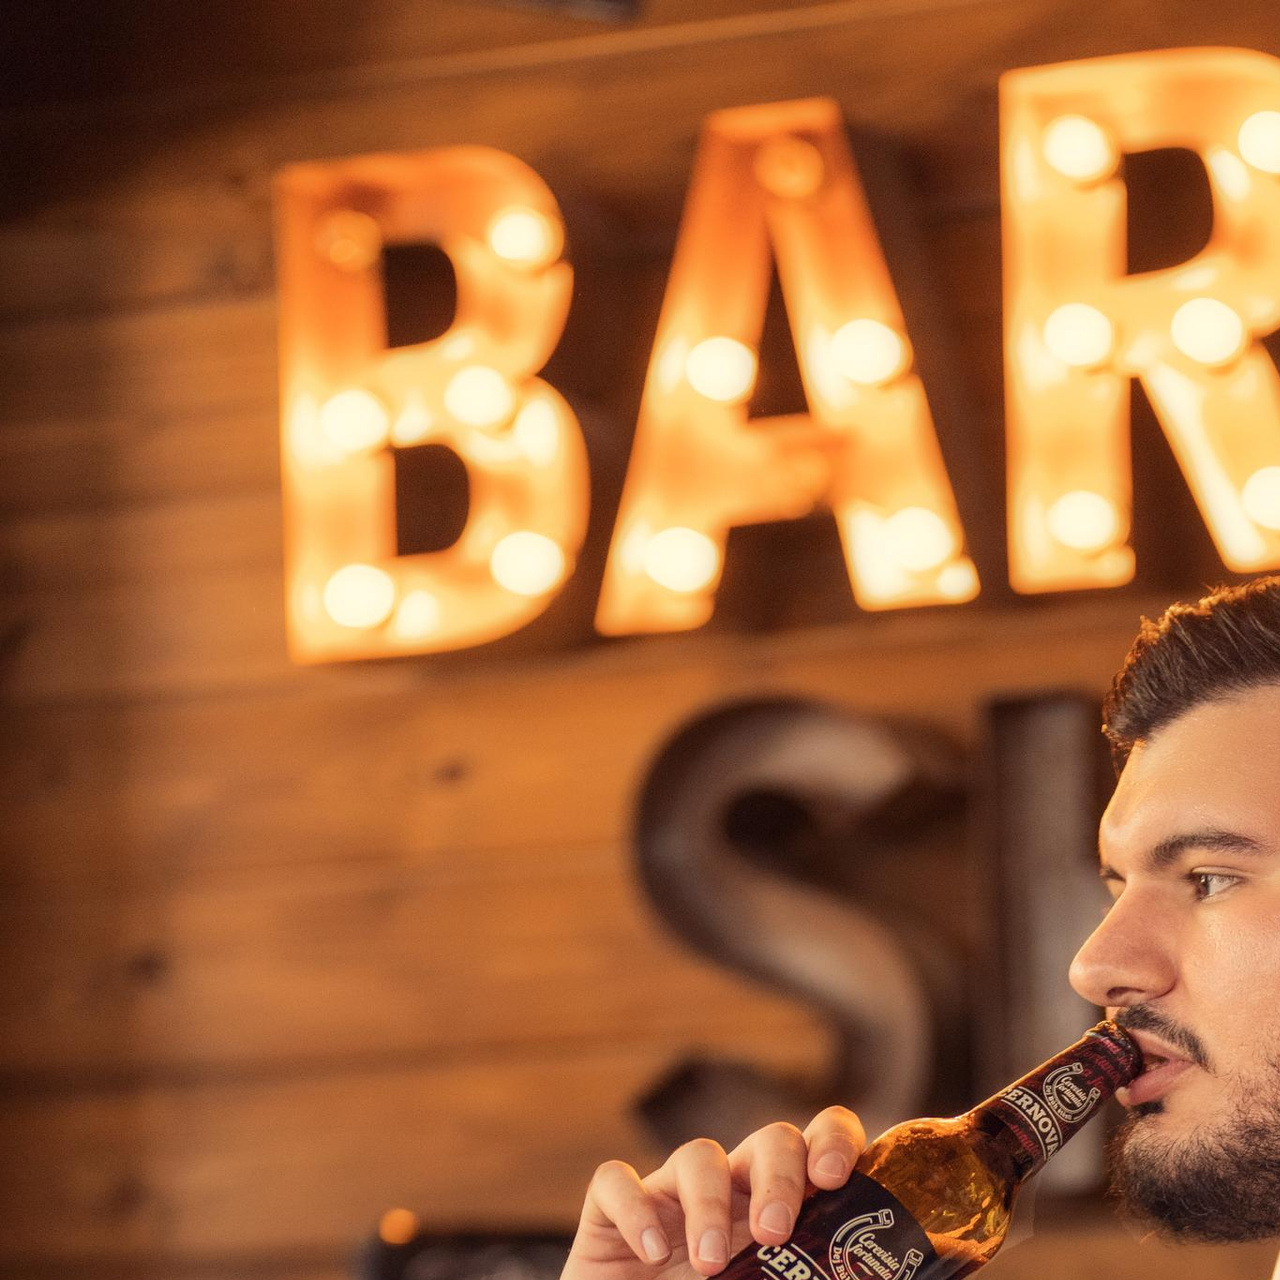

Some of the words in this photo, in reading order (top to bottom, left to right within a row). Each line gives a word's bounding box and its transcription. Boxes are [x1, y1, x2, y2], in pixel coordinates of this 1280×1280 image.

[832, 1246, 843, 1264] Dej
[847, 1244, 893, 1280] fortunata
[859, 1233, 900, 1271] Cerevisia
